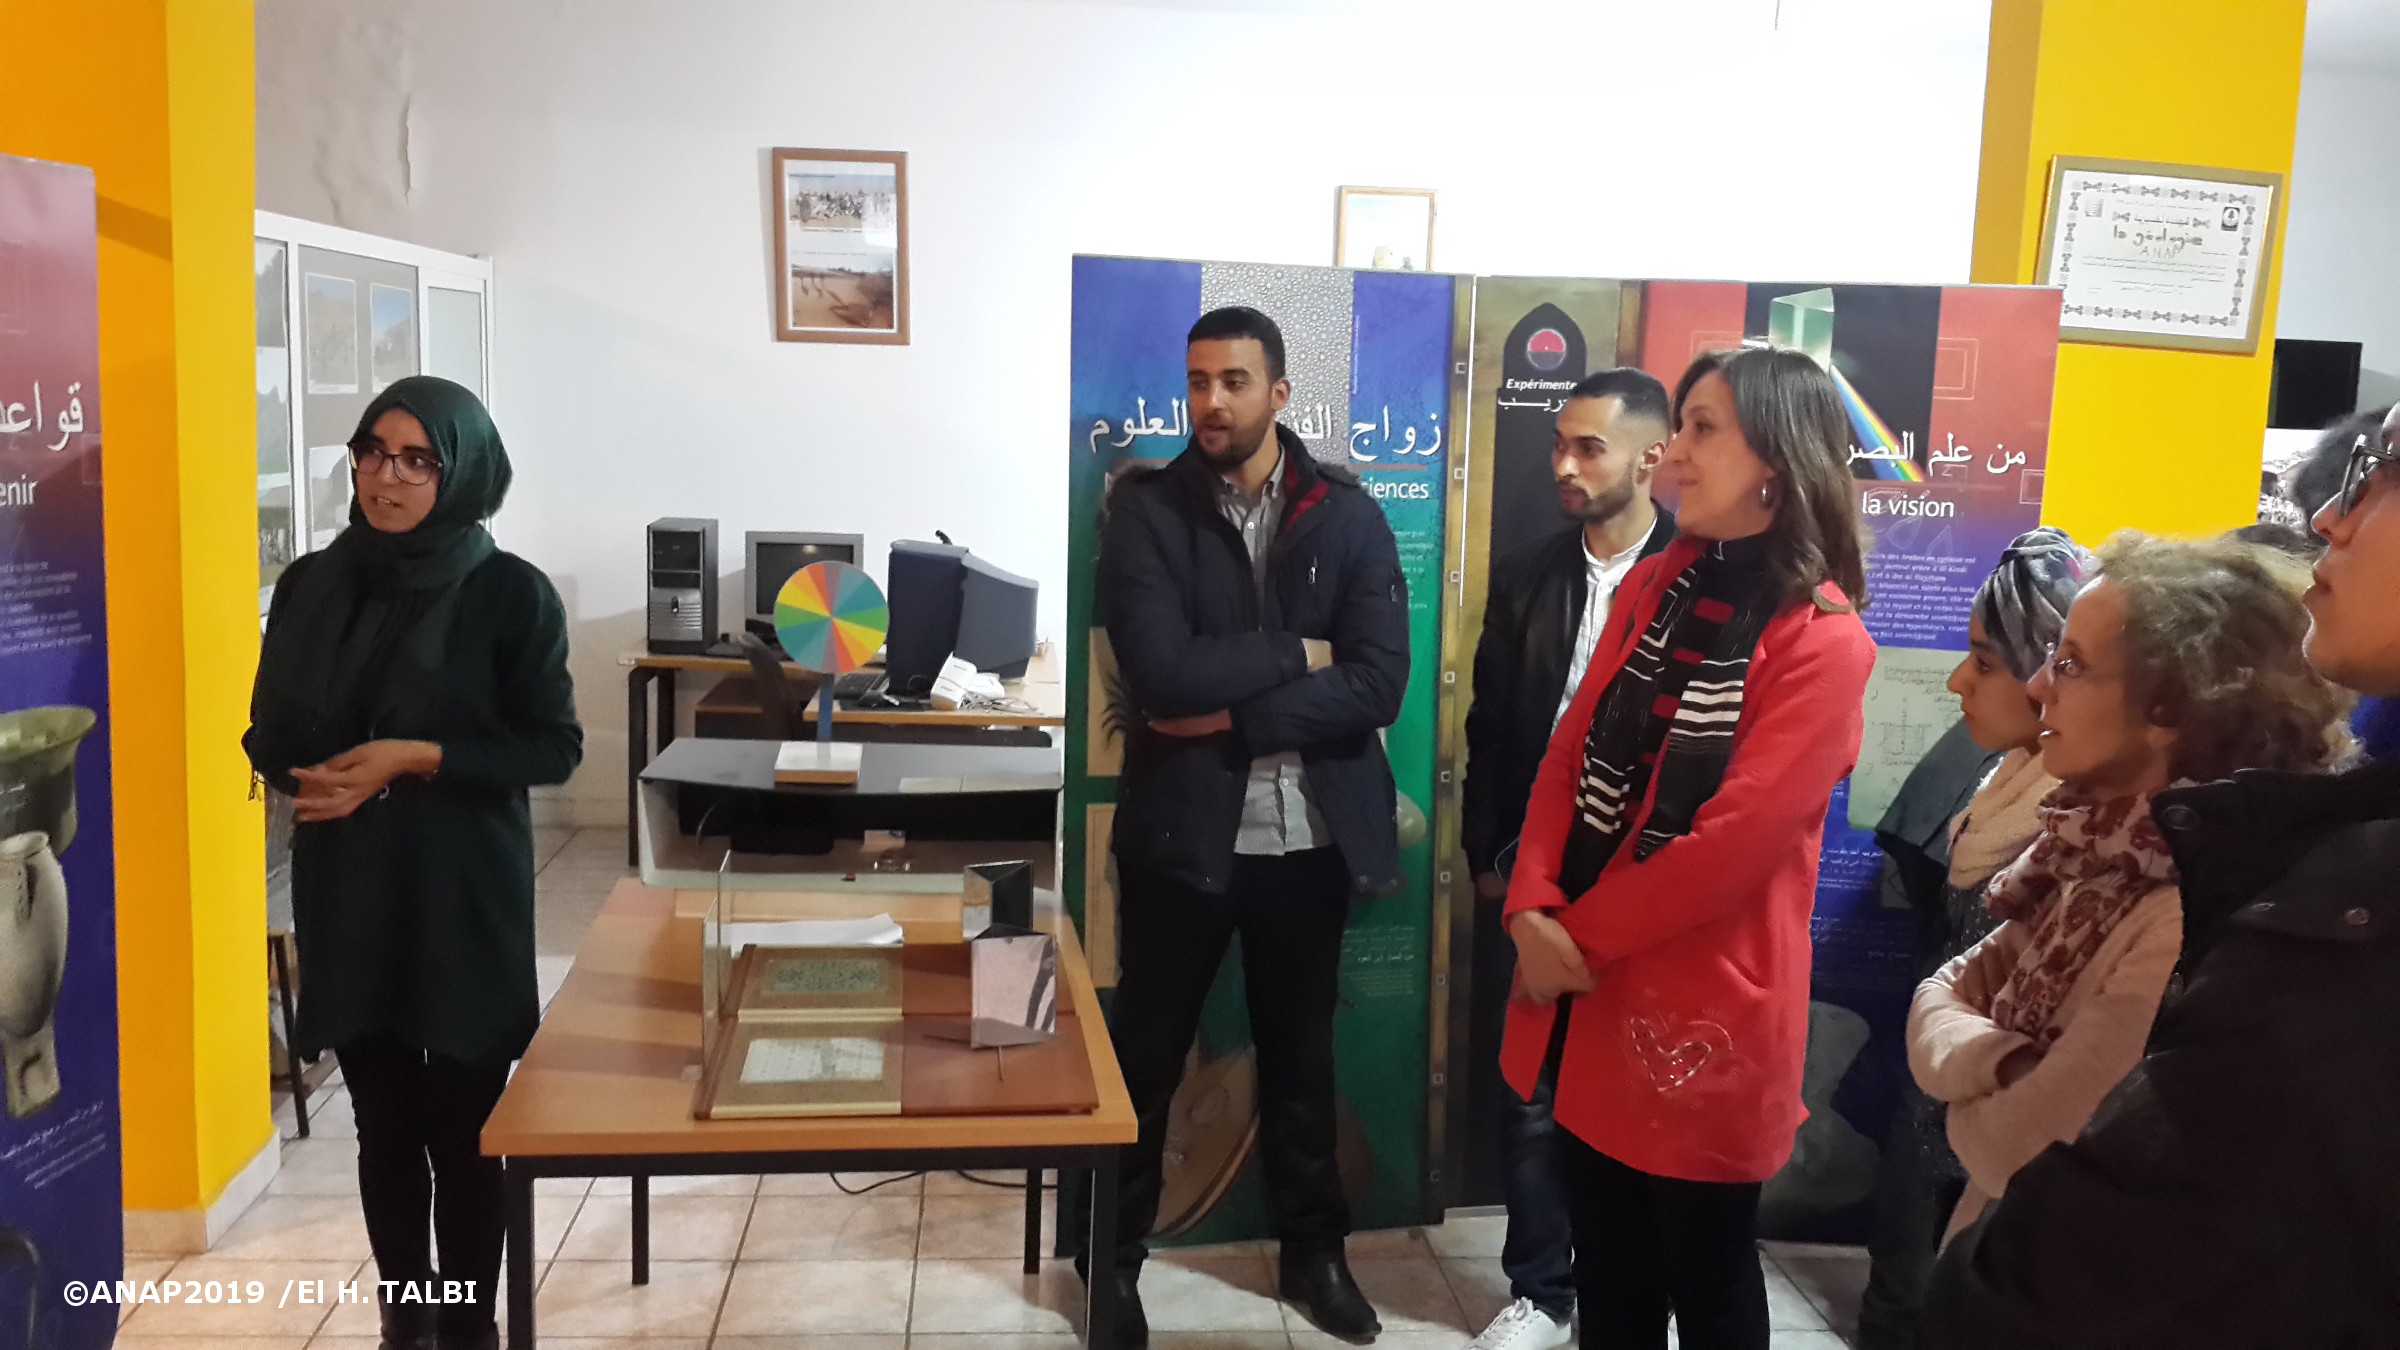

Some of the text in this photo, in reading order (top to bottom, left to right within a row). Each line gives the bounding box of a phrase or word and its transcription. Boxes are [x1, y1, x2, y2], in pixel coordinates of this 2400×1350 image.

[1349, 405, 1442, 463] زواج
[1927, 432, 1973, 477] علم
[1986, 443, 2027, 474] من
[1861, 491, 1955, 517] la vision
